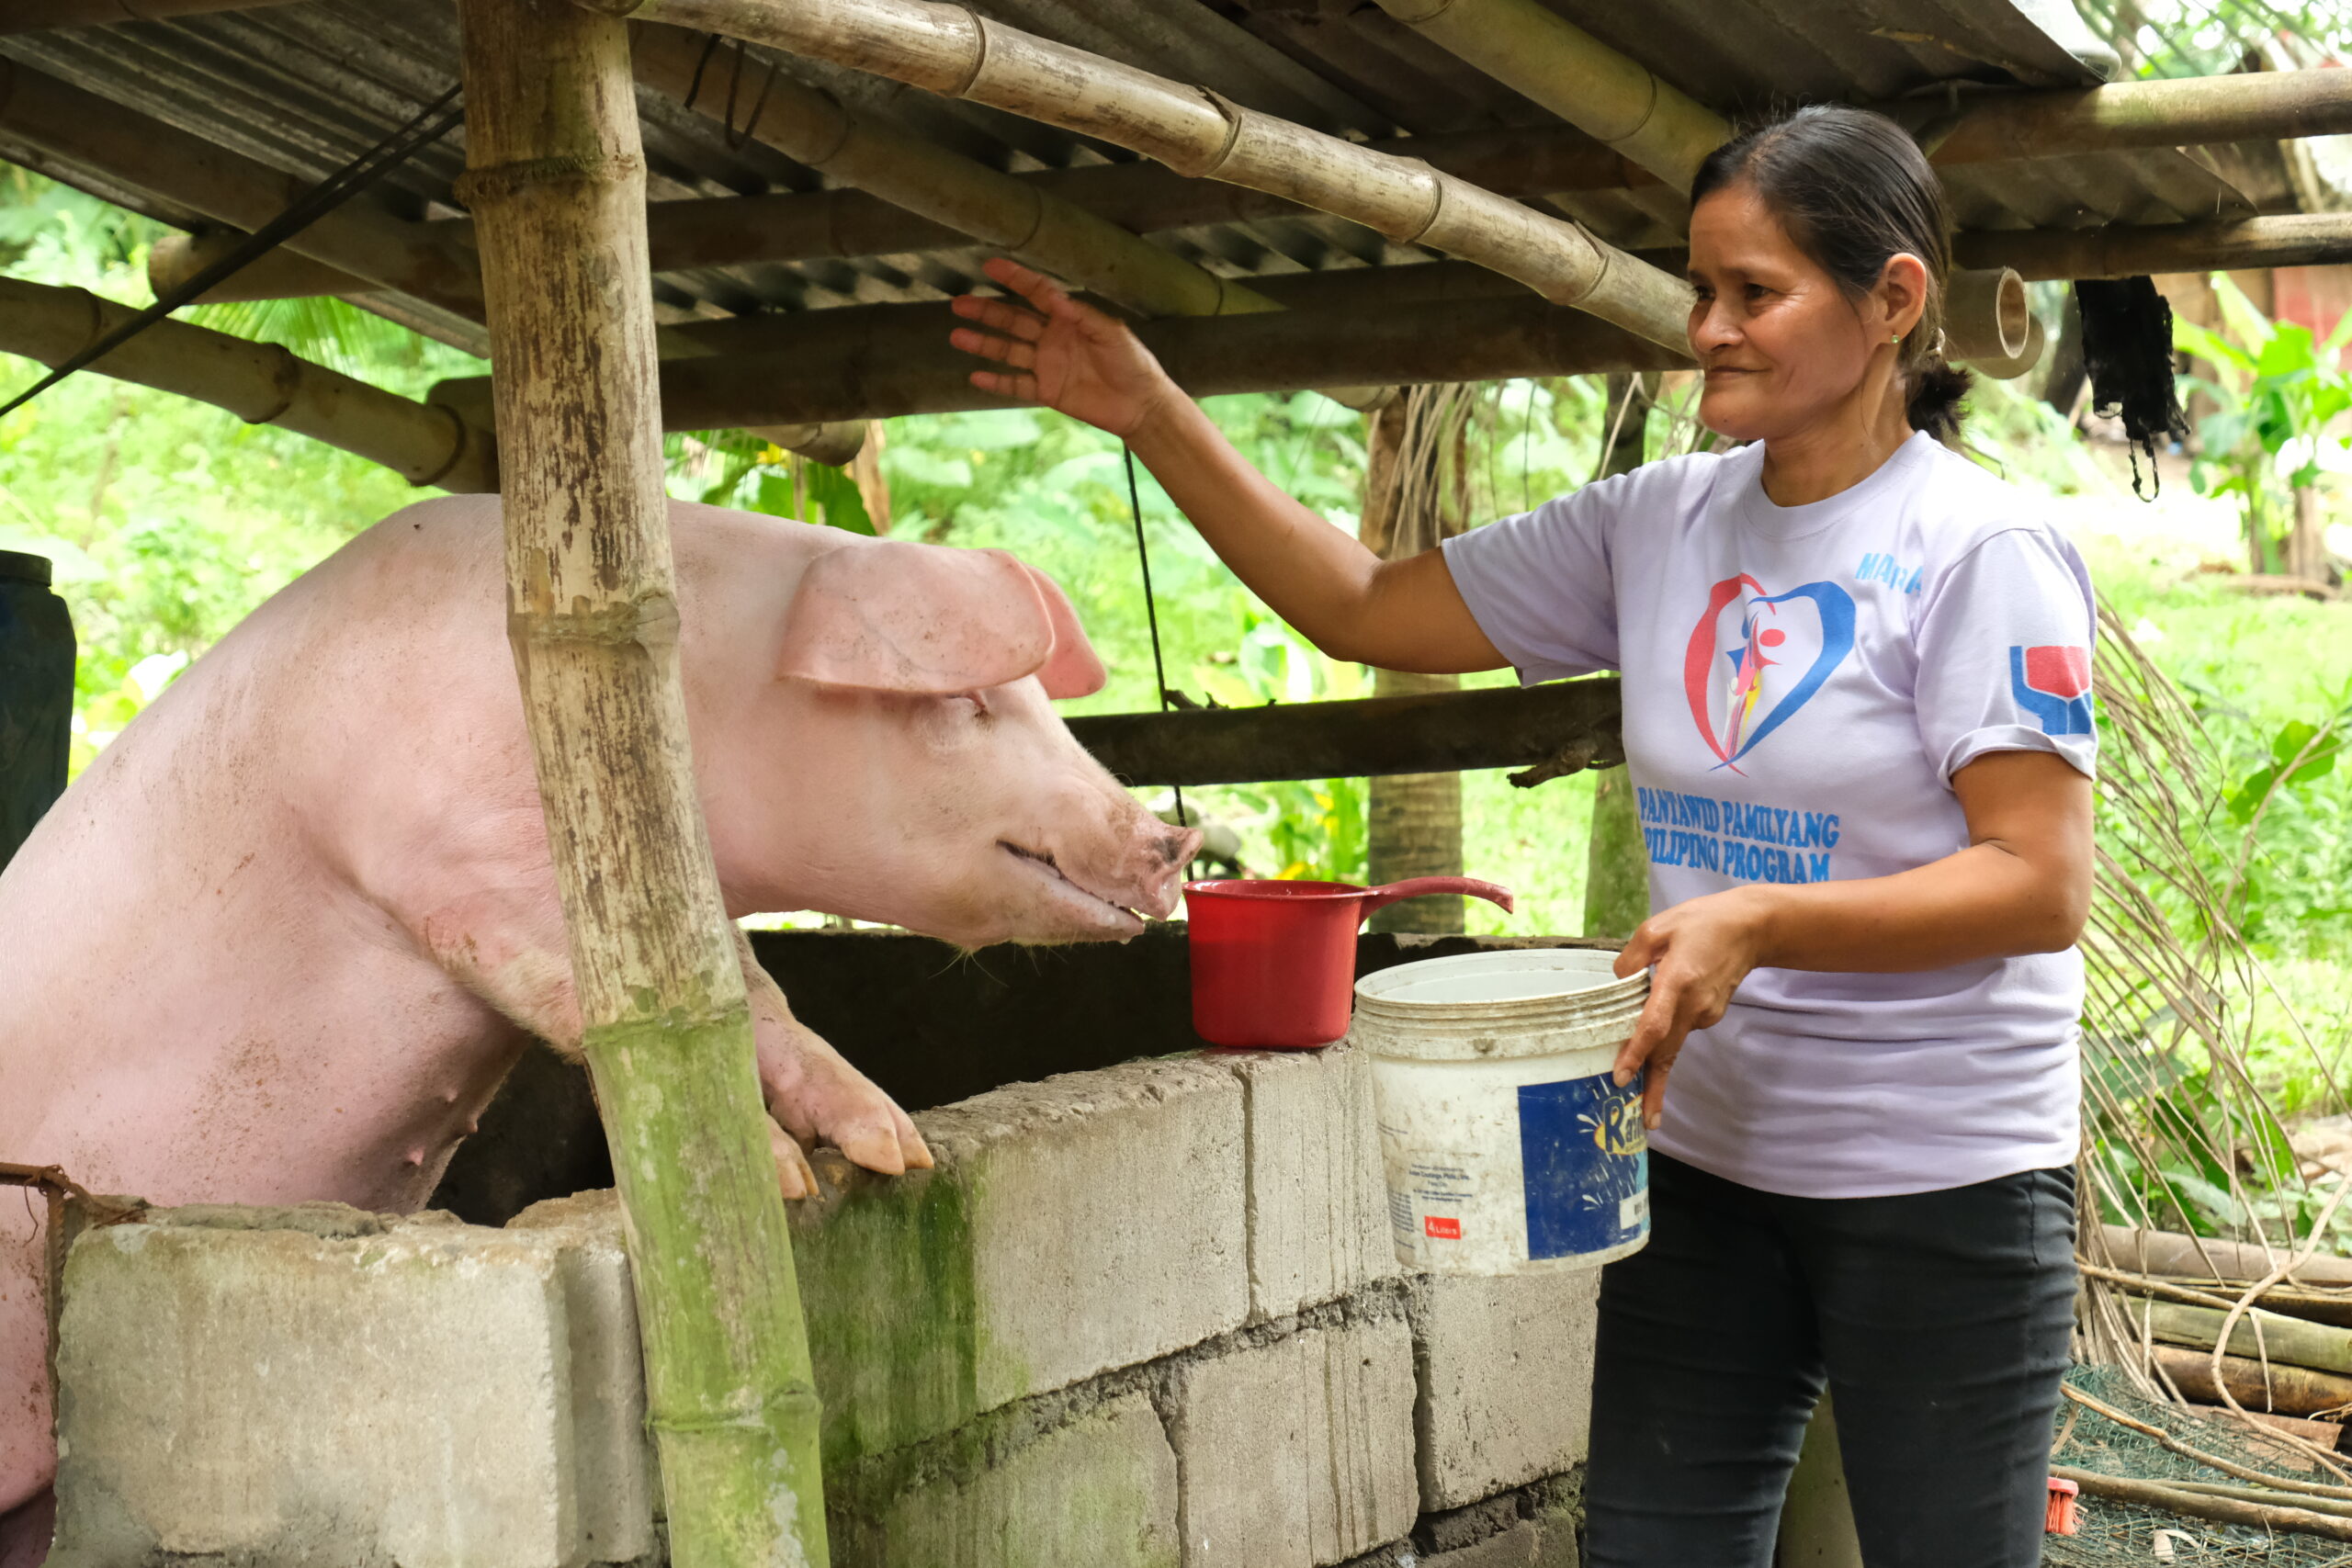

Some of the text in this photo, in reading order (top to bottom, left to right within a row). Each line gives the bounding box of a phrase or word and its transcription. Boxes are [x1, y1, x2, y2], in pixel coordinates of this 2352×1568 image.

[1637, 786, 1840, 849] PANTAWID PAMILYANG
[1644, 827, 1831, 885] PILIPINO PROGRAM
[1427, 1221, 1435, 1233] 4
